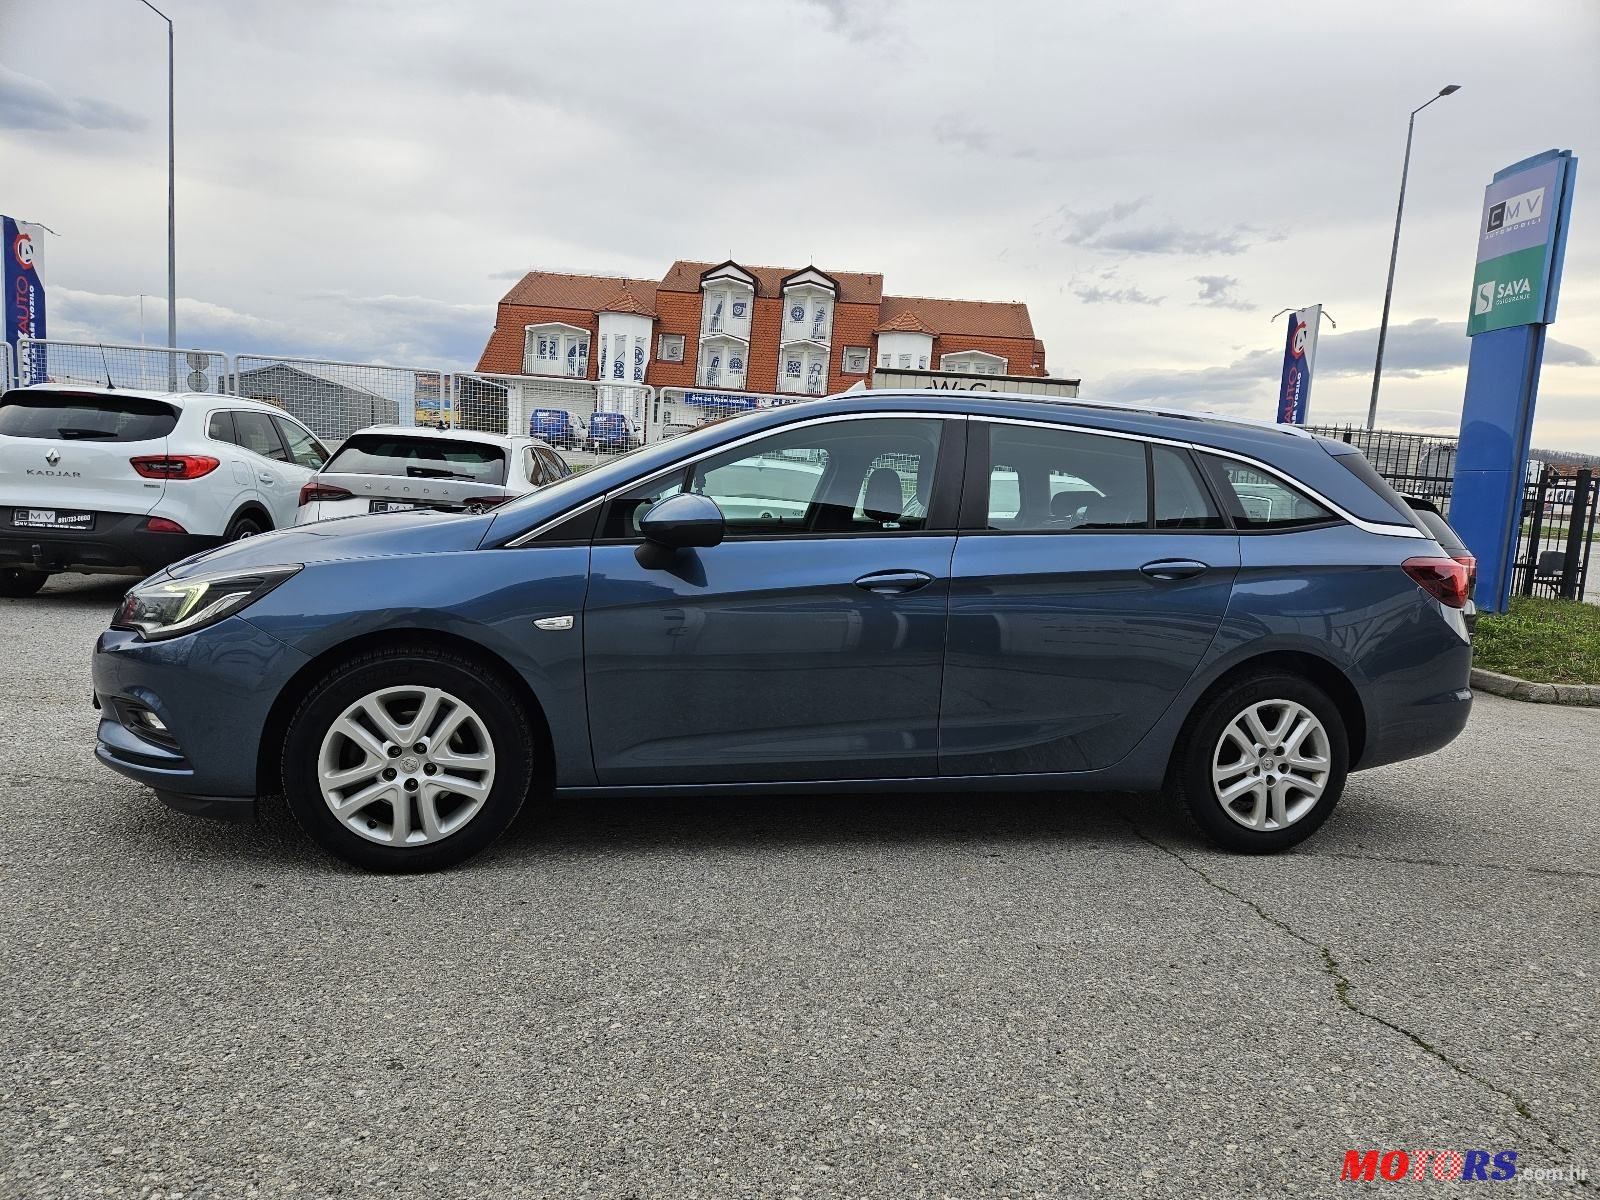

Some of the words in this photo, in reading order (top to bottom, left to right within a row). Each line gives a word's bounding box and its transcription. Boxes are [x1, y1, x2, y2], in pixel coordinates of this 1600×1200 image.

[1485, 218, 1541, 240] AUTOMOBILI
[1496, 278, 1531, 299] SAVA
[1294, 372, 1302, 407] VOZILO
[26, 469, 81, 478] KADJAR
